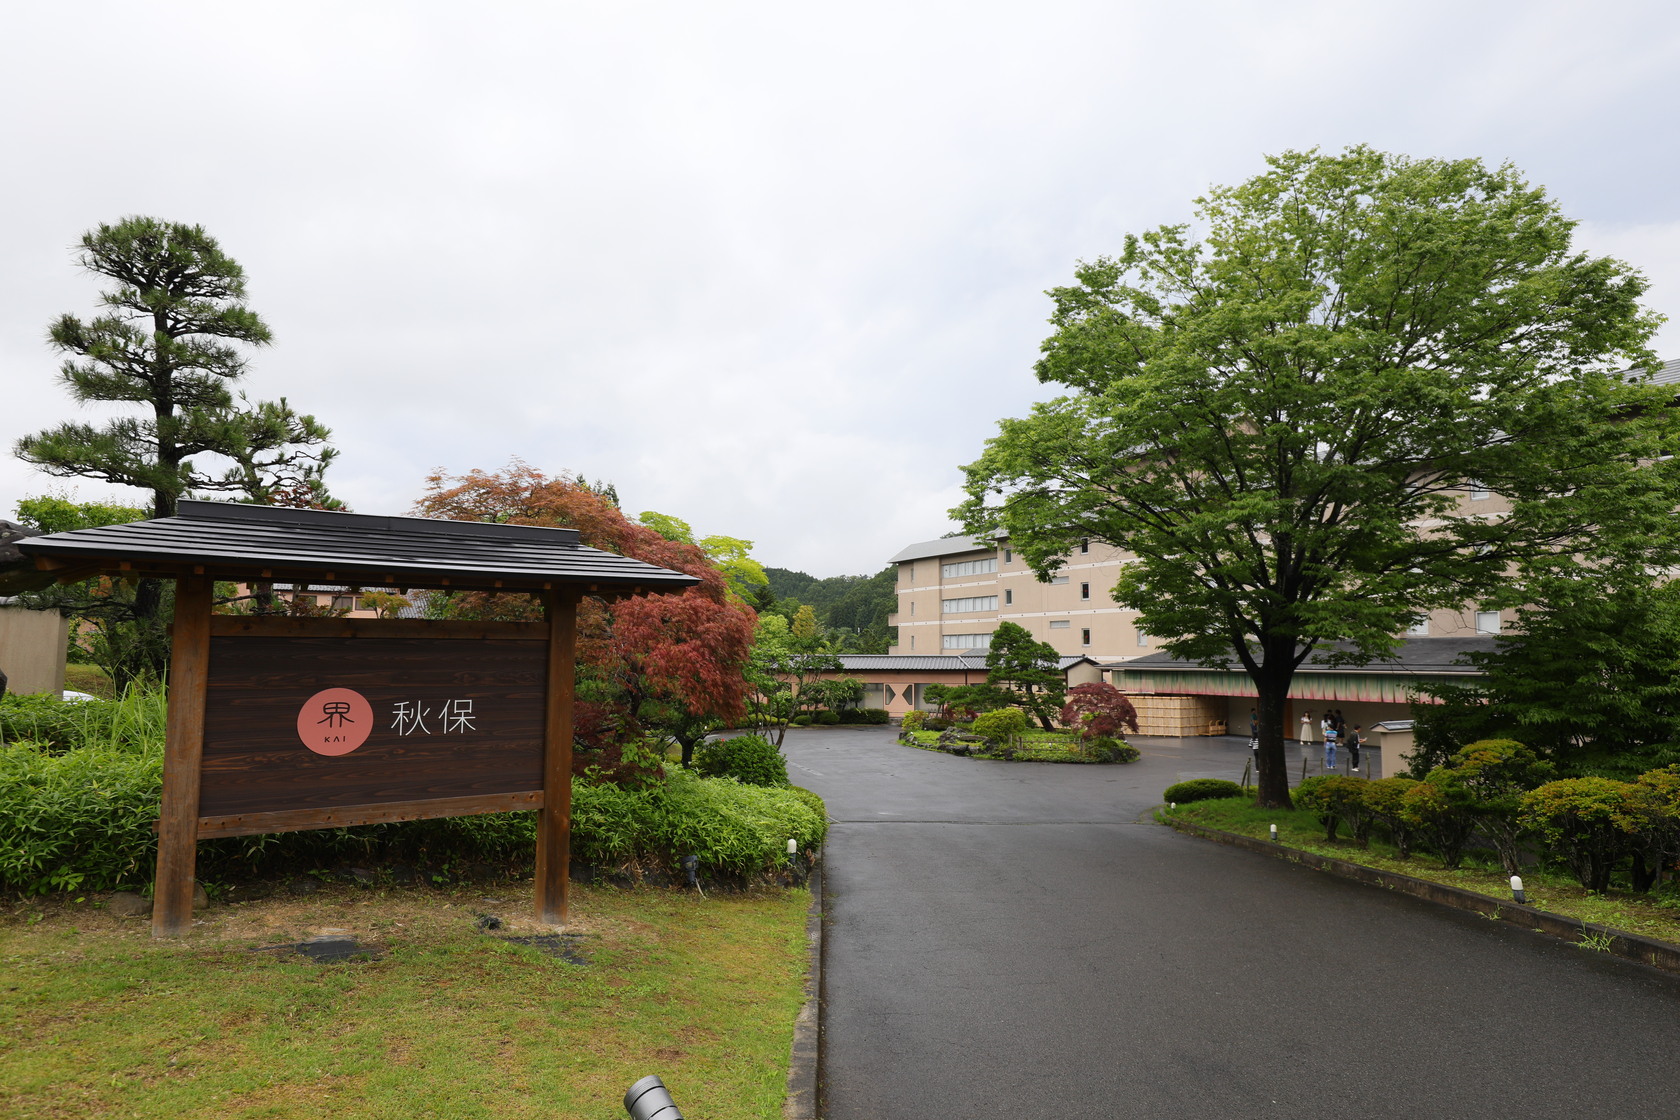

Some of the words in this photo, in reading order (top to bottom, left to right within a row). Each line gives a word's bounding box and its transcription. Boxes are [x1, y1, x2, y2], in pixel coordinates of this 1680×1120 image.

[317, 701, 355, 728] 界
[390, 699, 476, 737] 秋保
[324, 735, 346, 743] KAI
